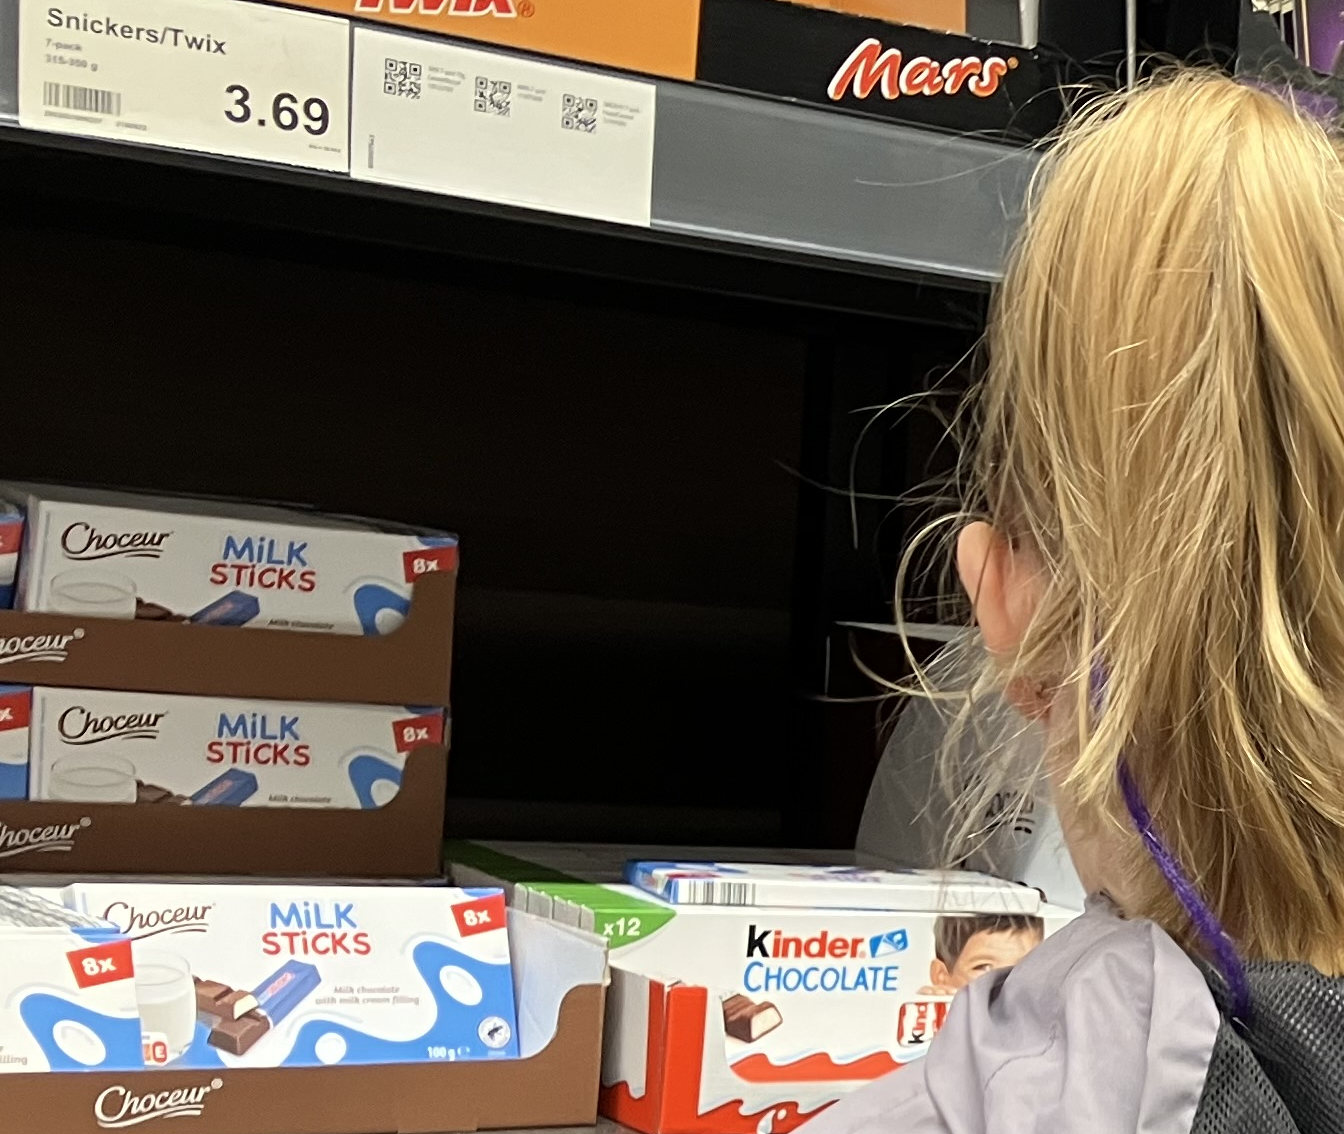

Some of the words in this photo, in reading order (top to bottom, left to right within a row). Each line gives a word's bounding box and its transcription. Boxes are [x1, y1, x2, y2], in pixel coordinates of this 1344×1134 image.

[47, 7, 228, 56] Snickers/Twix
[827, 38, 1006, 100] Mars
[224, 84, 331, 137] 3.69
[61, 521, 171, 557] Choceur
[411, 557, 439, 575] 8x
[0, 633, 75, 655] oceur
[57, 705, 166, 740] Choceur
[402, 726, 429, 743] 8x
[0, 822, 80, 849] hoceur
[103, 901, 212, 935] Choceur
[462, 907, 491, 926] 8x
[602, 917, 642, 937] x12
[81, 957, 117, 976] 8x
[743, 961, 899, 992] CHOCOLATE
[94, 1084, 213, 1123] Choceur
